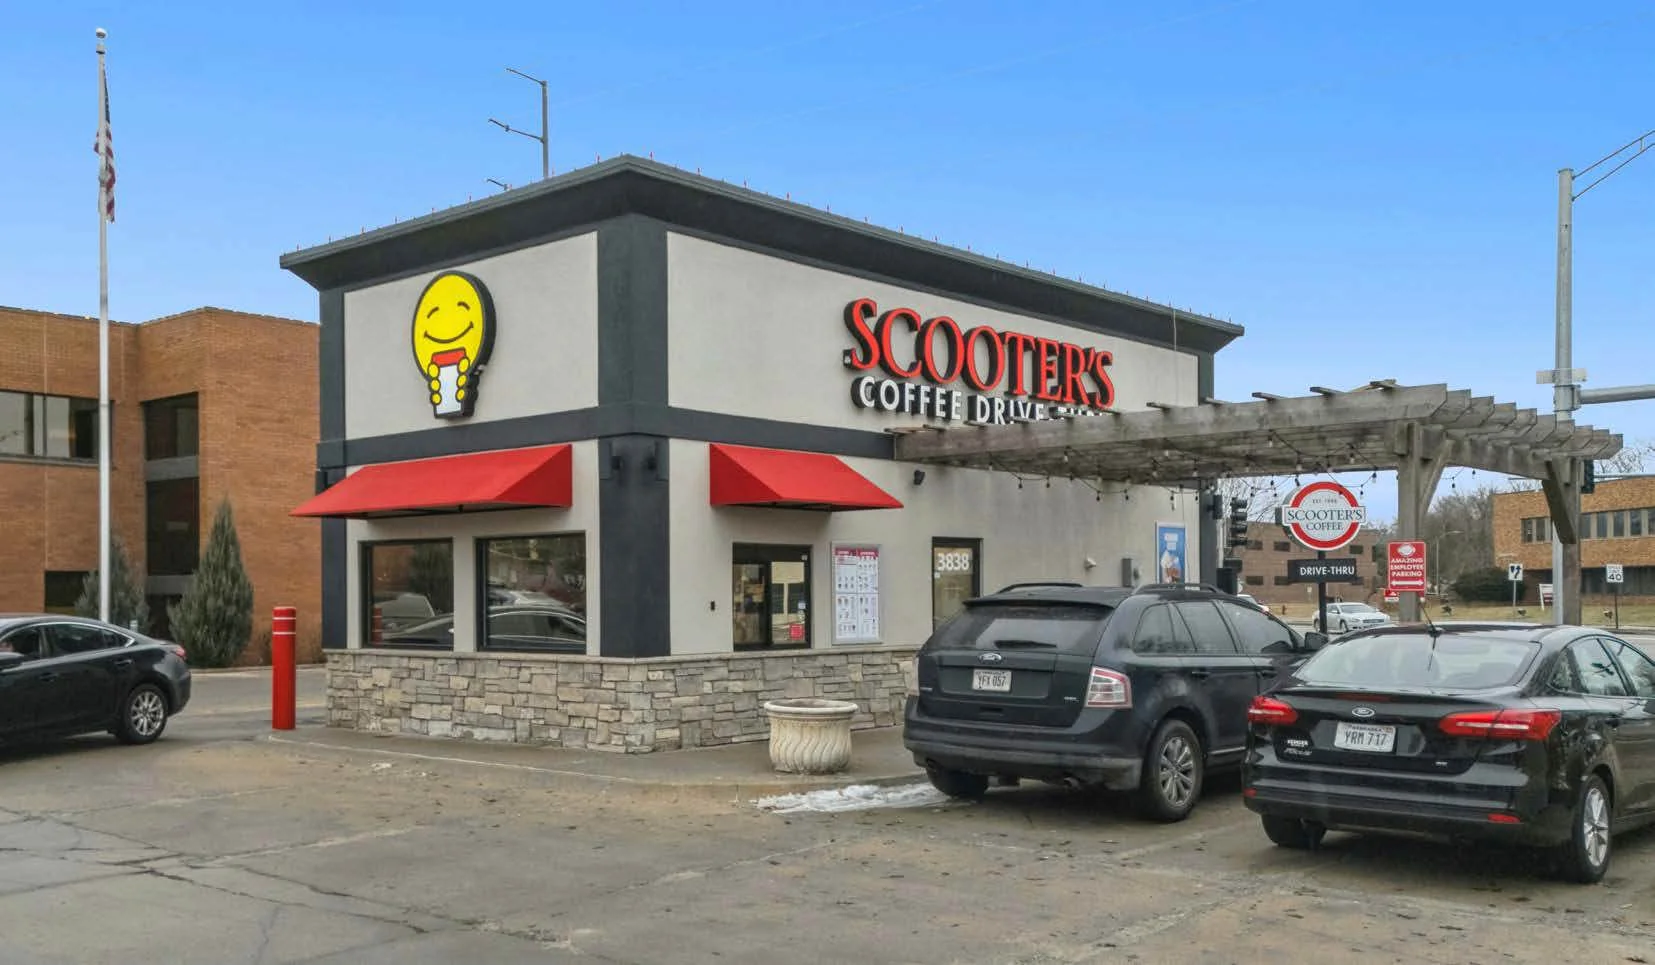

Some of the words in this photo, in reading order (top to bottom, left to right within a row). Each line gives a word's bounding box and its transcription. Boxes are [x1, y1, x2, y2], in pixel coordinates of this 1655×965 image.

[848, 297, 1115, 409] SCOOTER'S
[857, 375, 962, 421] COFFEE
[979, 393, 1050, 425] DRIVE
[1287, 509, 1364, 522] SCOOTER'S
[1306, 521, 1344, 532] COFFEE
[936, 551, 970, 571] 3838
[1300, 565, 1355, 577] DRIVE-THRU
[1608, 573, 1622, 581] 40
[1345, 730, 1365, 745] YRM
[1367, 732, 1388, 746] 717
